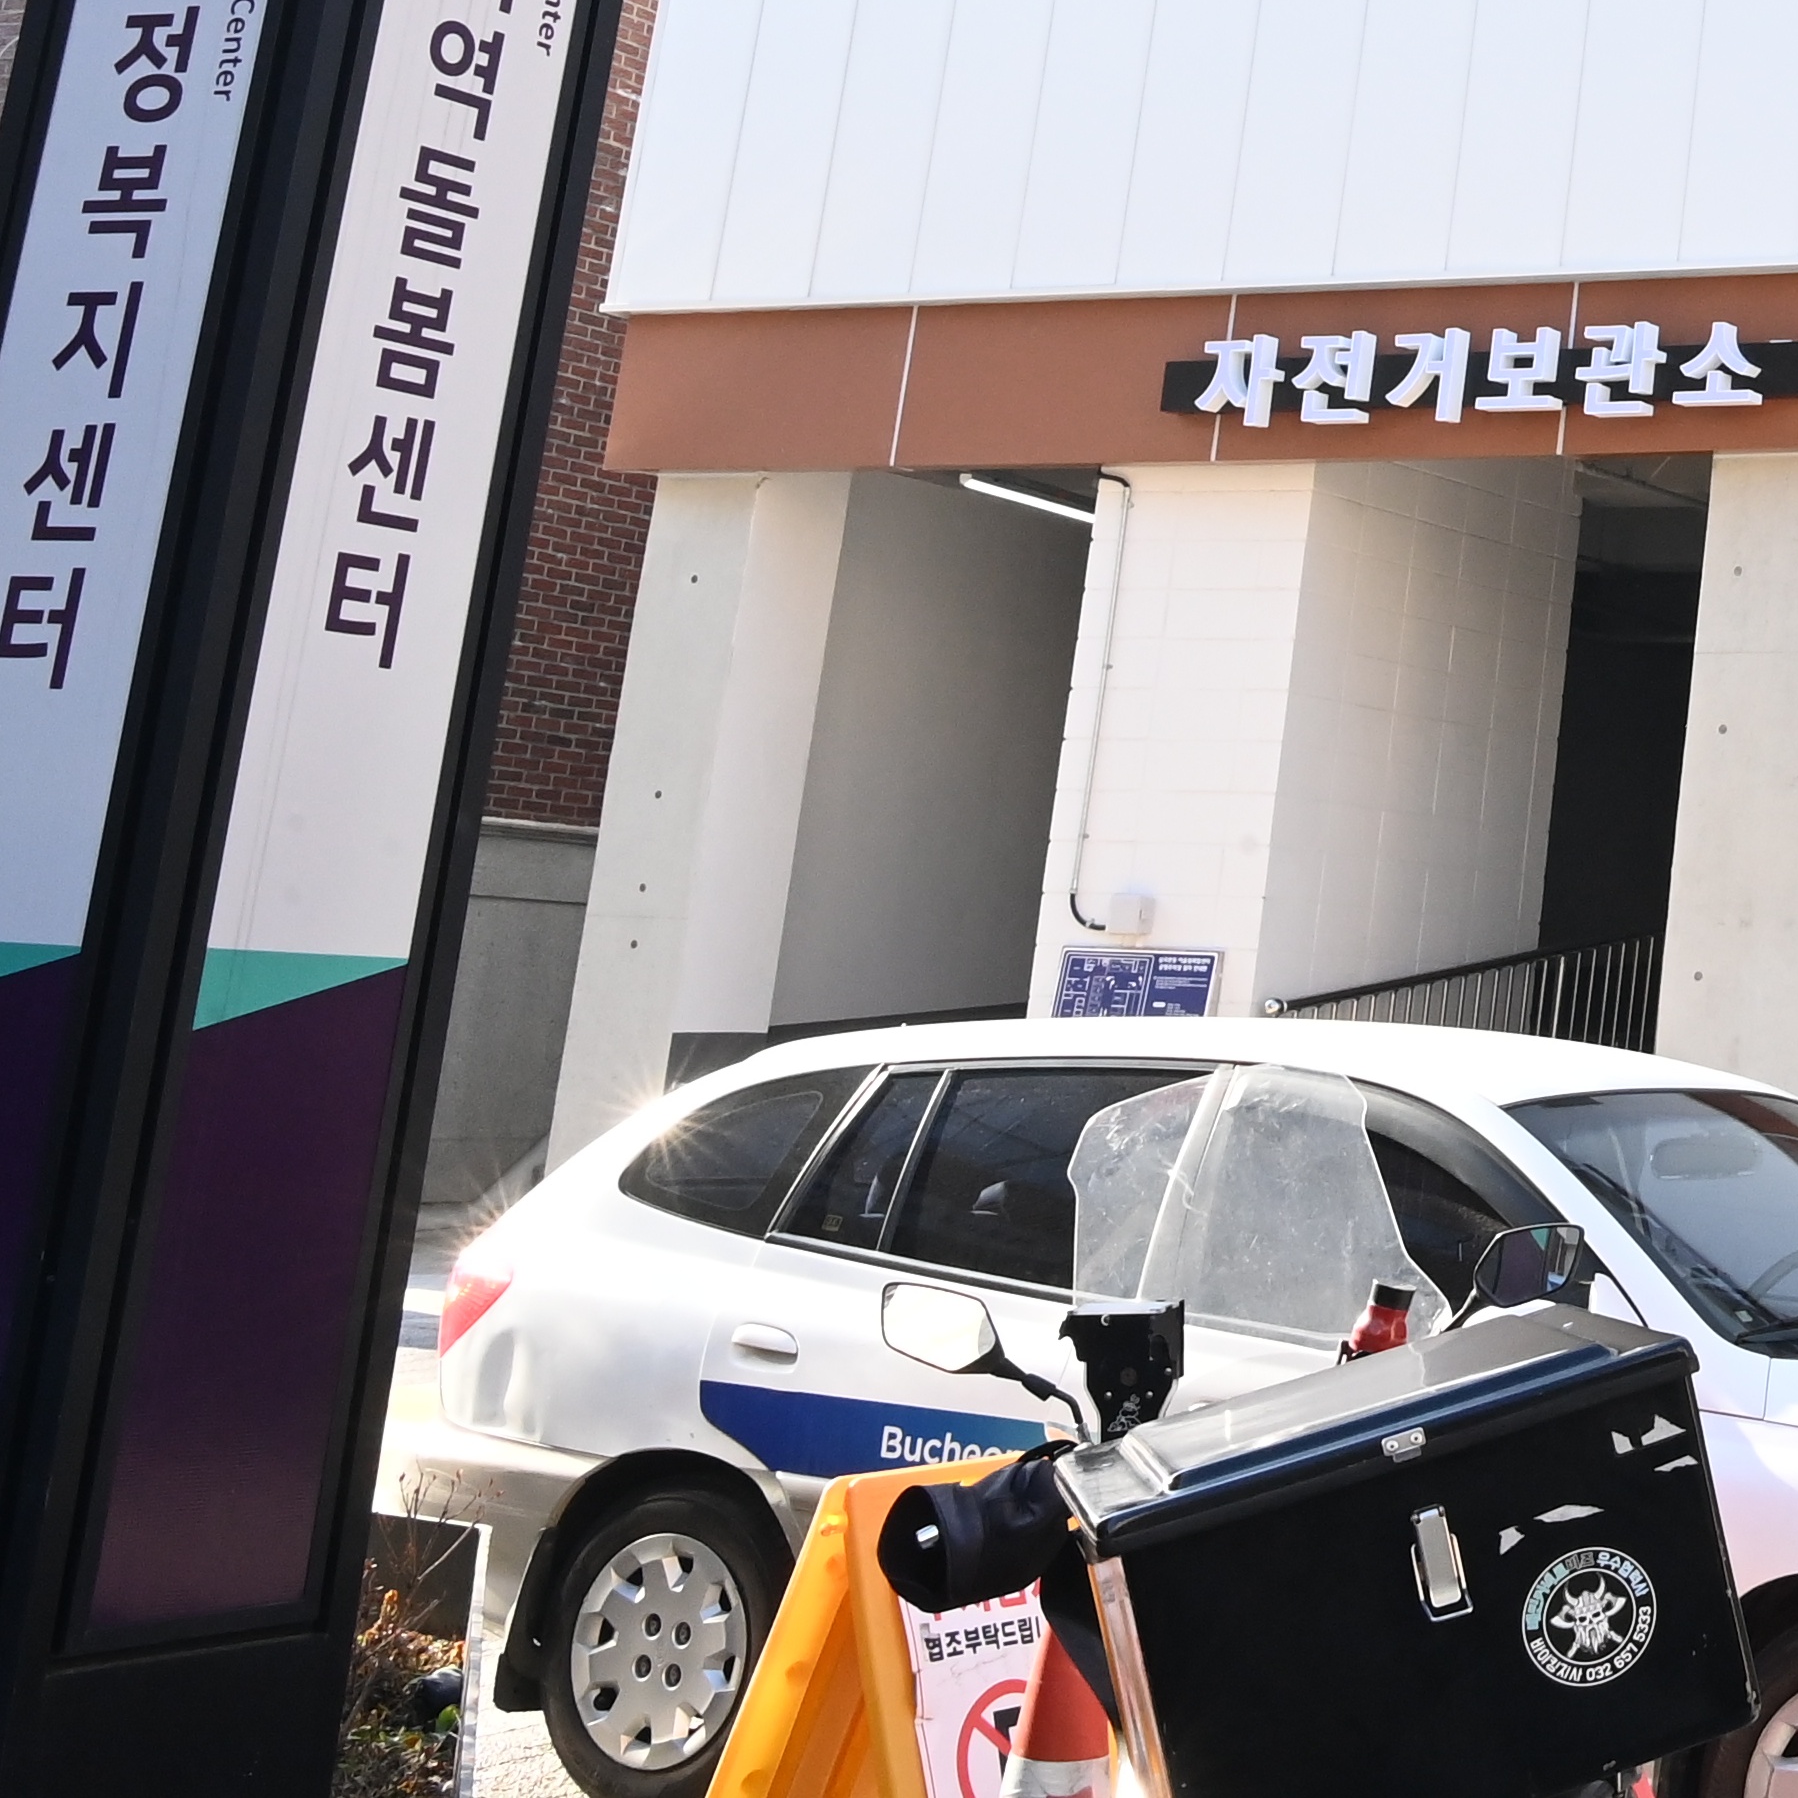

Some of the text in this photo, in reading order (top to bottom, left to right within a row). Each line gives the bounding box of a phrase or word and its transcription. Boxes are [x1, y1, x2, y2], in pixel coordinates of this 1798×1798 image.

[1195, 321, 1763, 428] 자전거보관소
[880, 1425, 1024, 1464] Buche
[1586, 1663, 1613, 1681] 032
[1614, 1642, 1638, 1669] 657
[1633, 1606, 1652, 1643] 5333
